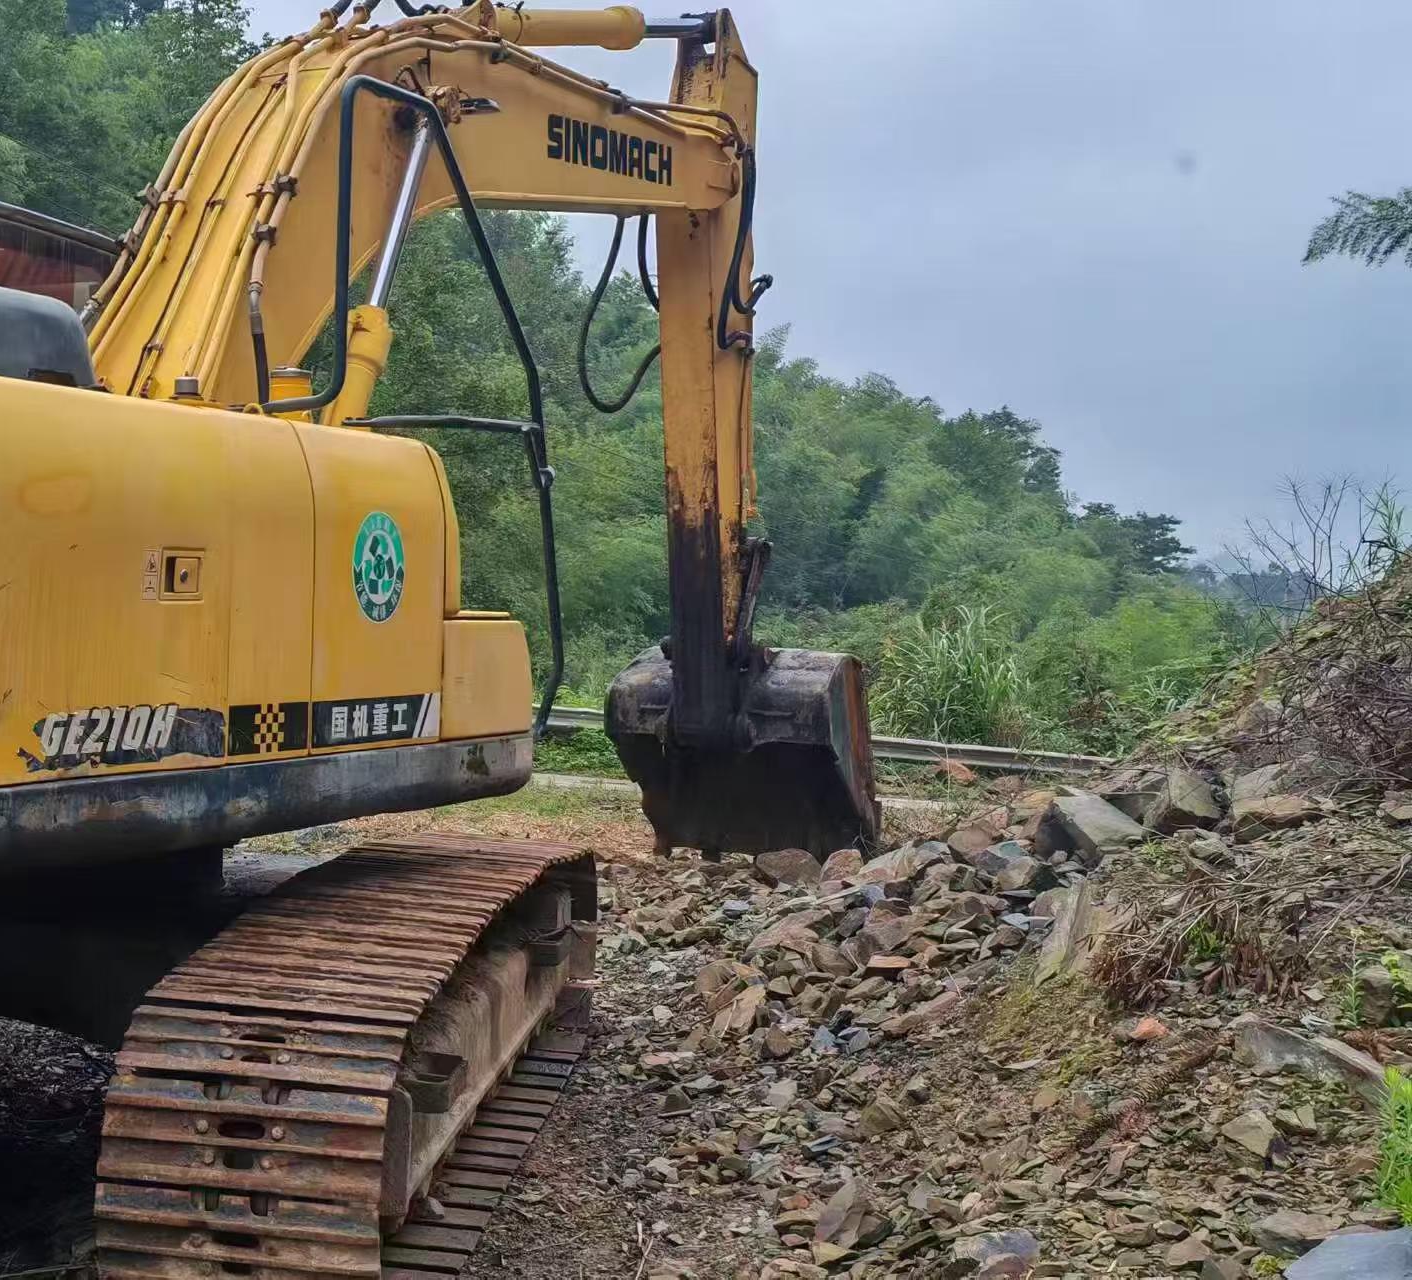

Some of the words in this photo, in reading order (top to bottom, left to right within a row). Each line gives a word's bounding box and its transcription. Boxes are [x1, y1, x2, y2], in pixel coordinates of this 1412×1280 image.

[547, 113, 673, 187] SINOMACH
[40, 703, 180, 757] GE210H
[331, 702, 408, 739] 国机重工
